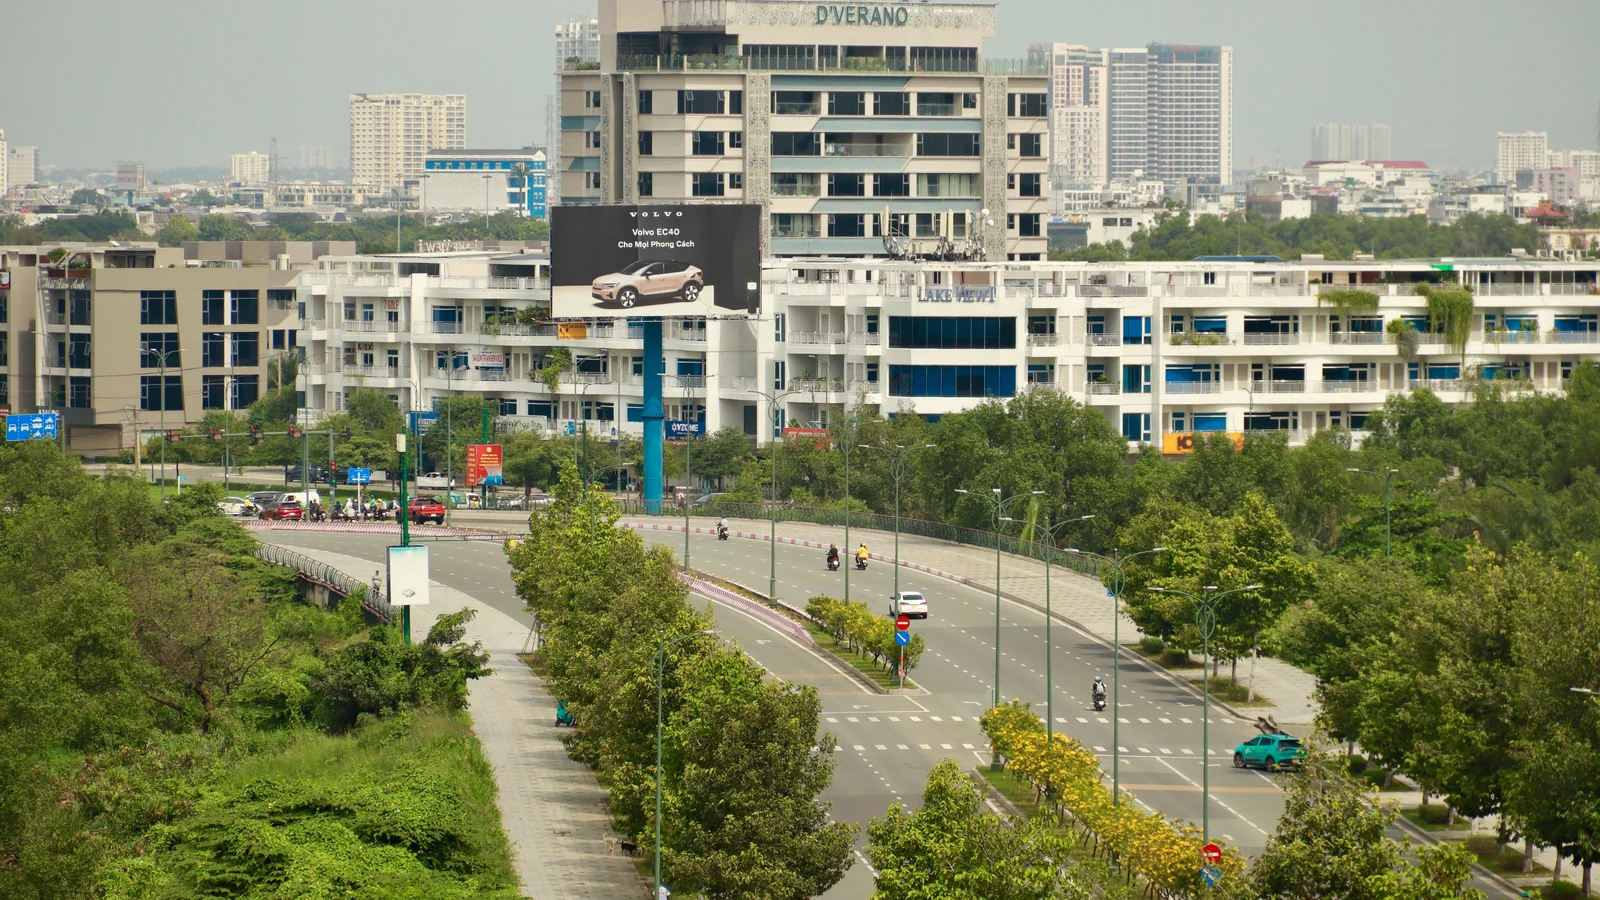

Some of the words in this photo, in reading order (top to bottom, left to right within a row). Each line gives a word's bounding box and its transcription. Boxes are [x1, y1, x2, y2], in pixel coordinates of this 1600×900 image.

[816, 5, 908, 27] D'VERANO
[632, 228, 655, 236] Volvo
[656, 228, 680, 236] EC40
[634, 241, 649, 249] Mọi
[650, 240, 675, 249] Phong
[676, 239, 695, 248] Cách
[917, 286, 952, 303] LAKE
[955, 286, 987, 303] VIEW
